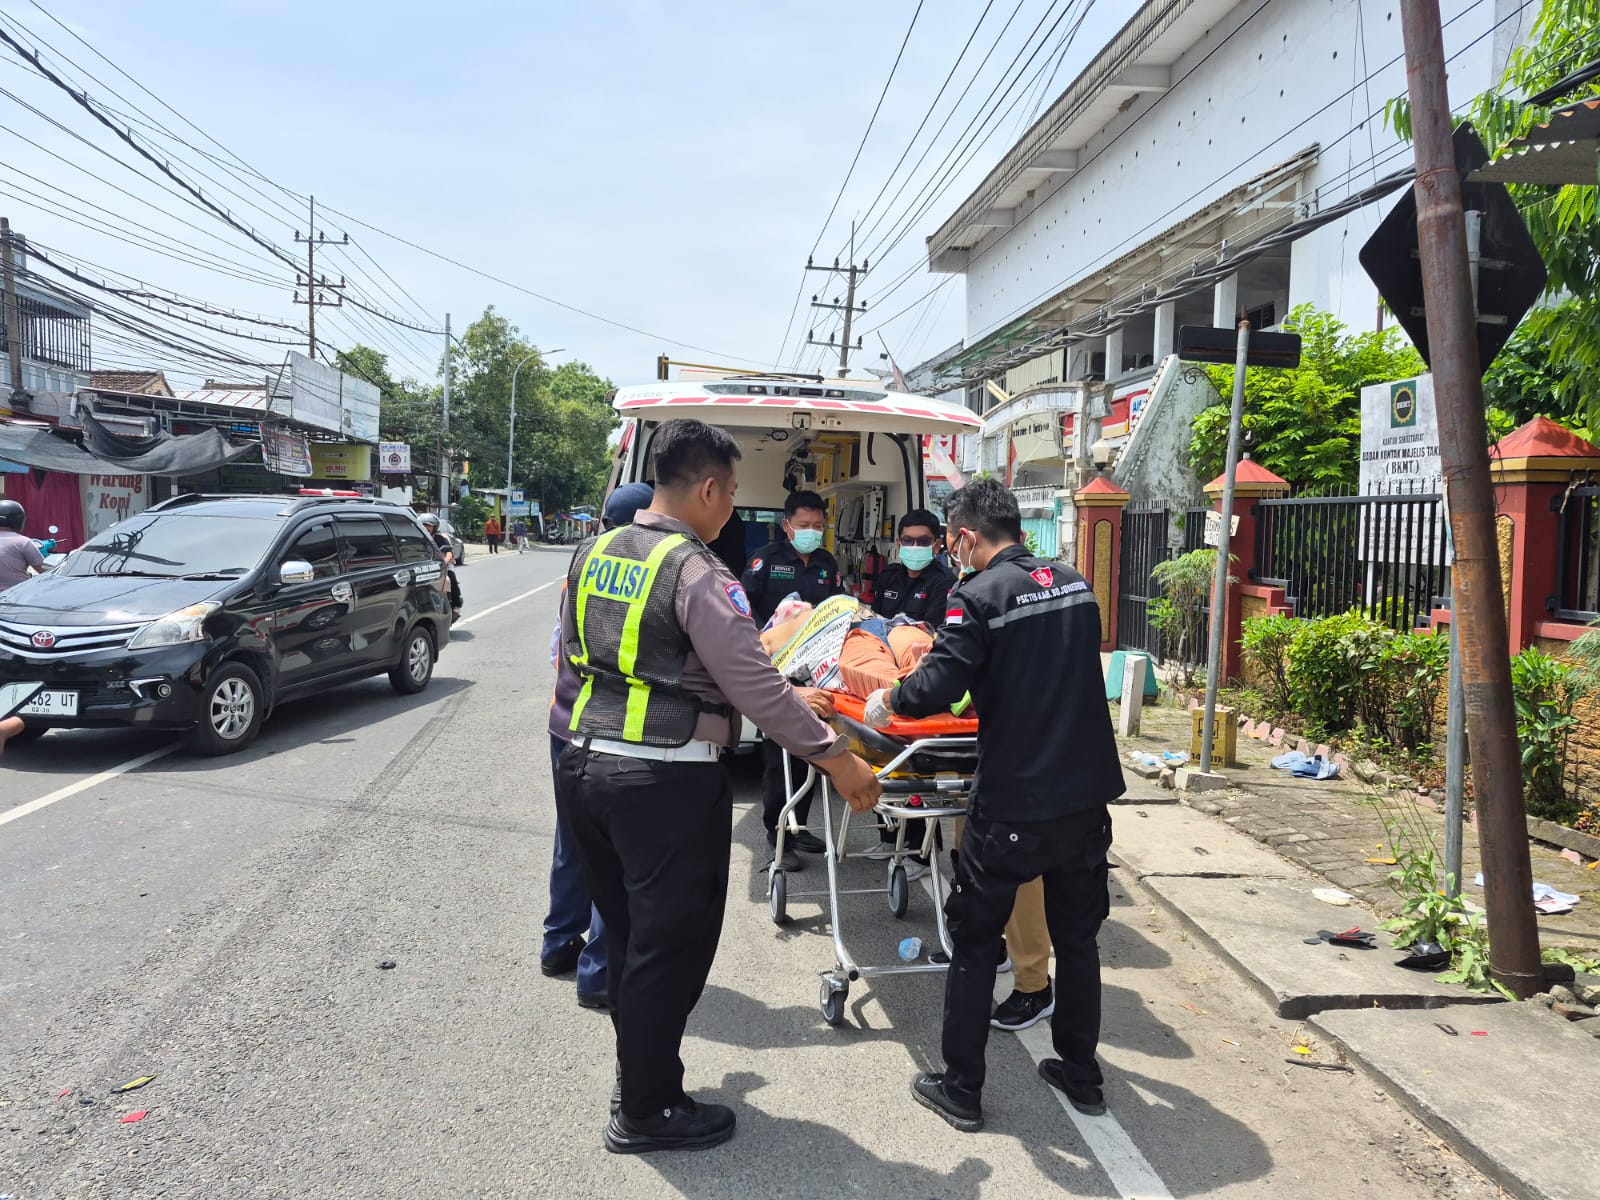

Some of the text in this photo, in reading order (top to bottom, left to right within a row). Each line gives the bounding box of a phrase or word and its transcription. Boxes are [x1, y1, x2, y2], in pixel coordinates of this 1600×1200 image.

[1401, 446, 1426, 459] MAJELIS
[90, 474, 143, 493] Warung
[98, 492, 131, 511] Kopi
[583, 557, 650, 600] POLISI
[61, 694, 75, 707] UT
